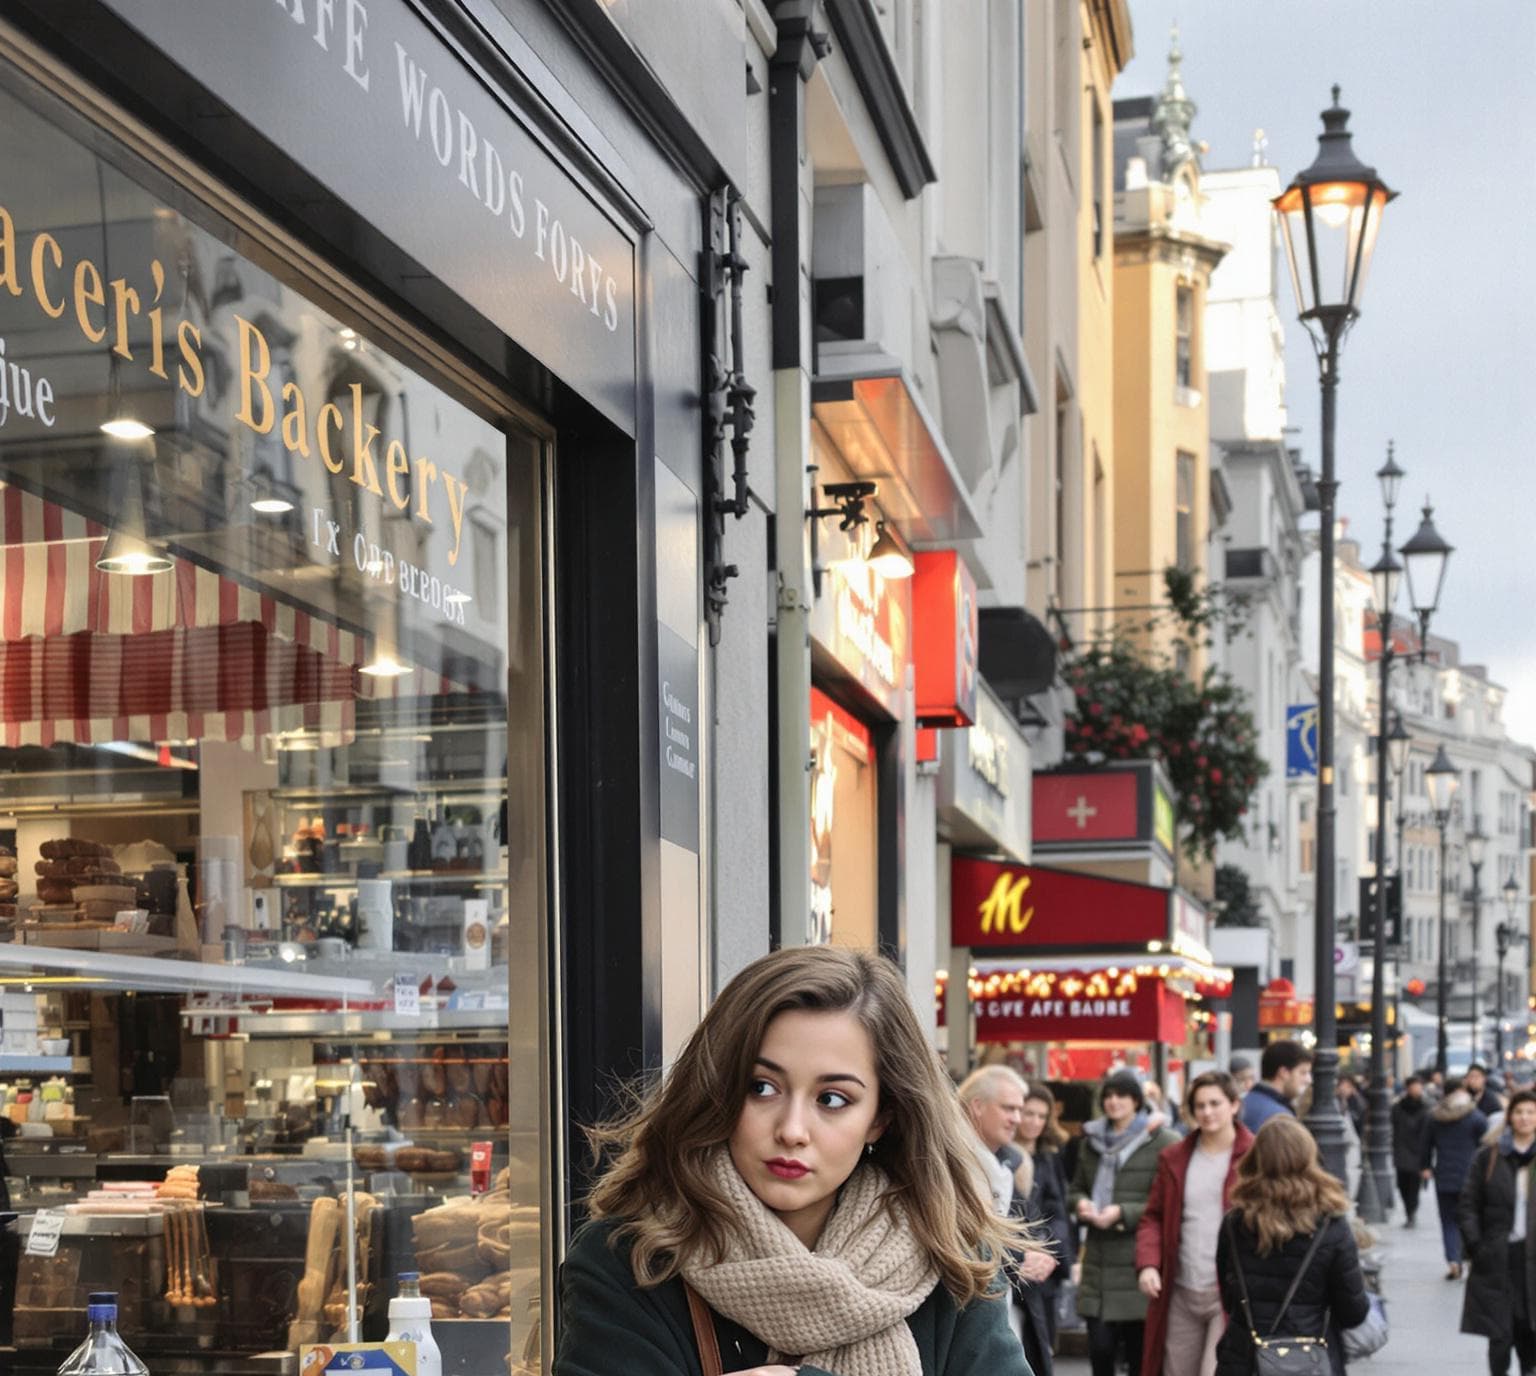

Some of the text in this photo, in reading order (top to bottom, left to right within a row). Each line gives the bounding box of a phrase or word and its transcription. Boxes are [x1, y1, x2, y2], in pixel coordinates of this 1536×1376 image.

[275, 0, 618, 332] FE WORDS FORYS
[234, 314, 469, 566] Backery
